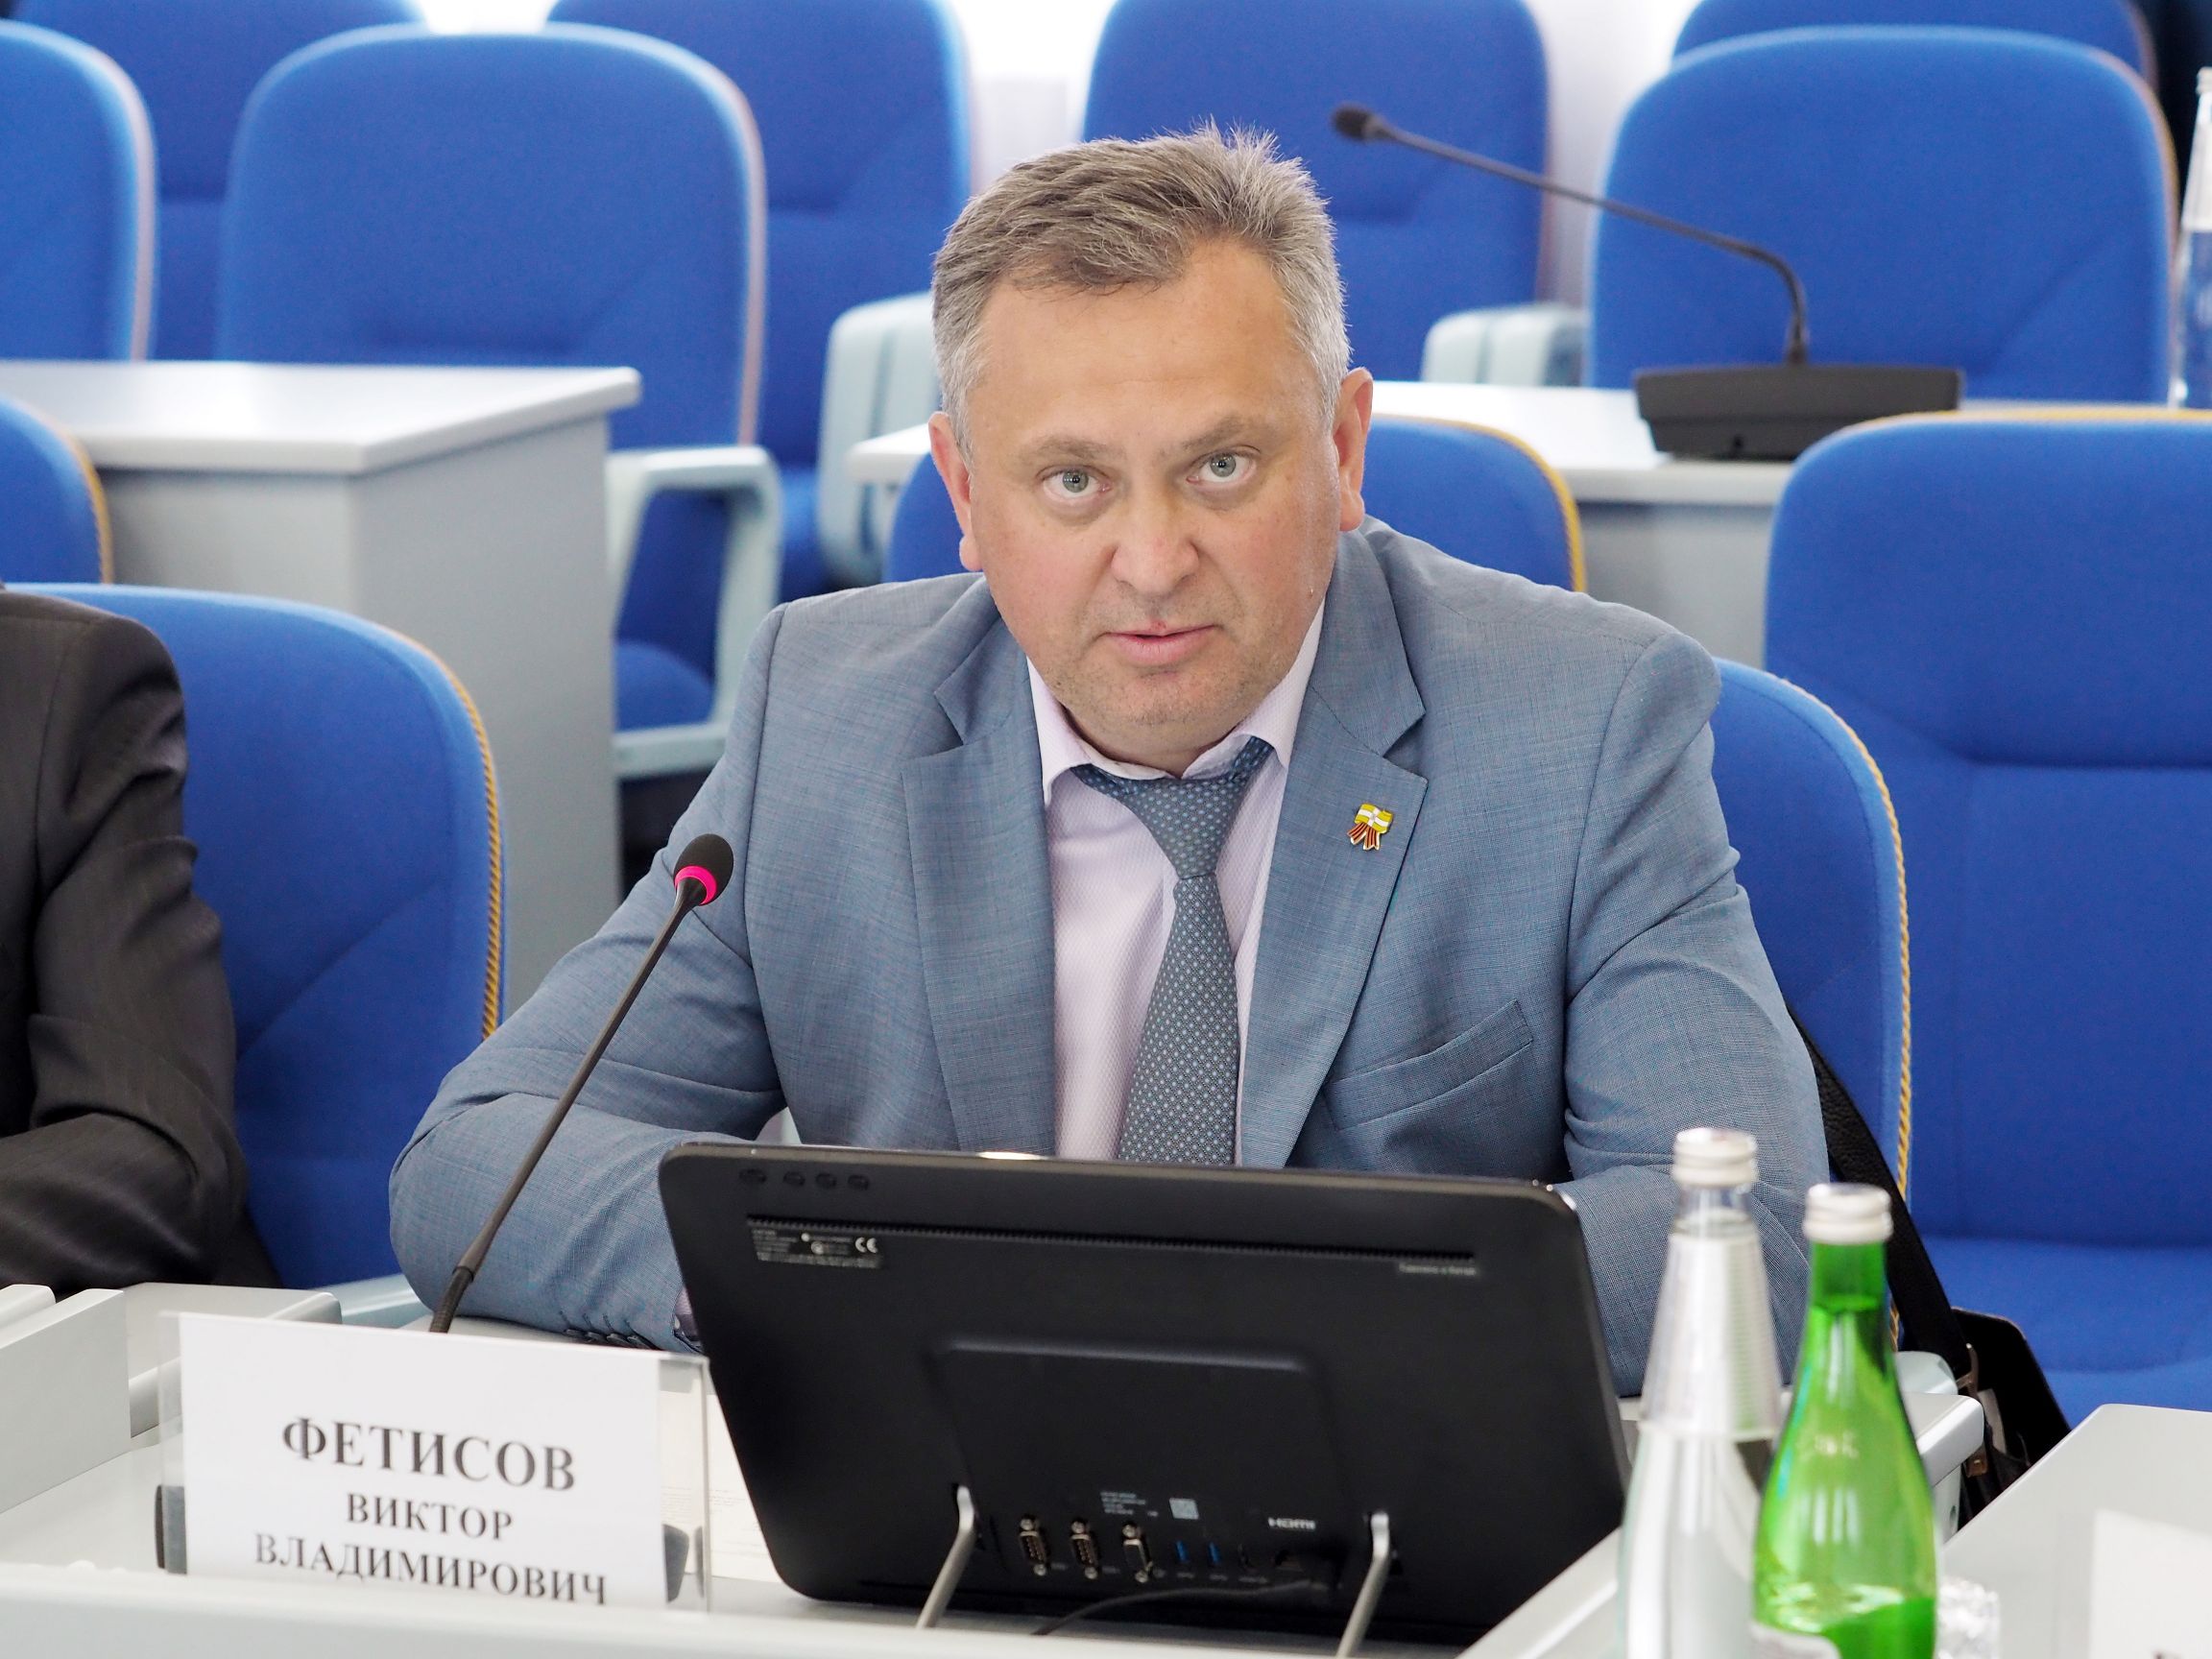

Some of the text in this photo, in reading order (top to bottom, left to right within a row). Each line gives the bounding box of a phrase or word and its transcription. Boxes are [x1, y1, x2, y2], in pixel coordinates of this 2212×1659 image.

[282, 1416, 576, 1491] ФЕТИСОВ
[347, 1492, 513, 1541] ВИКТОР
[254, 1533, 607, 1605] ВЛАДИМИРОВИЧ
